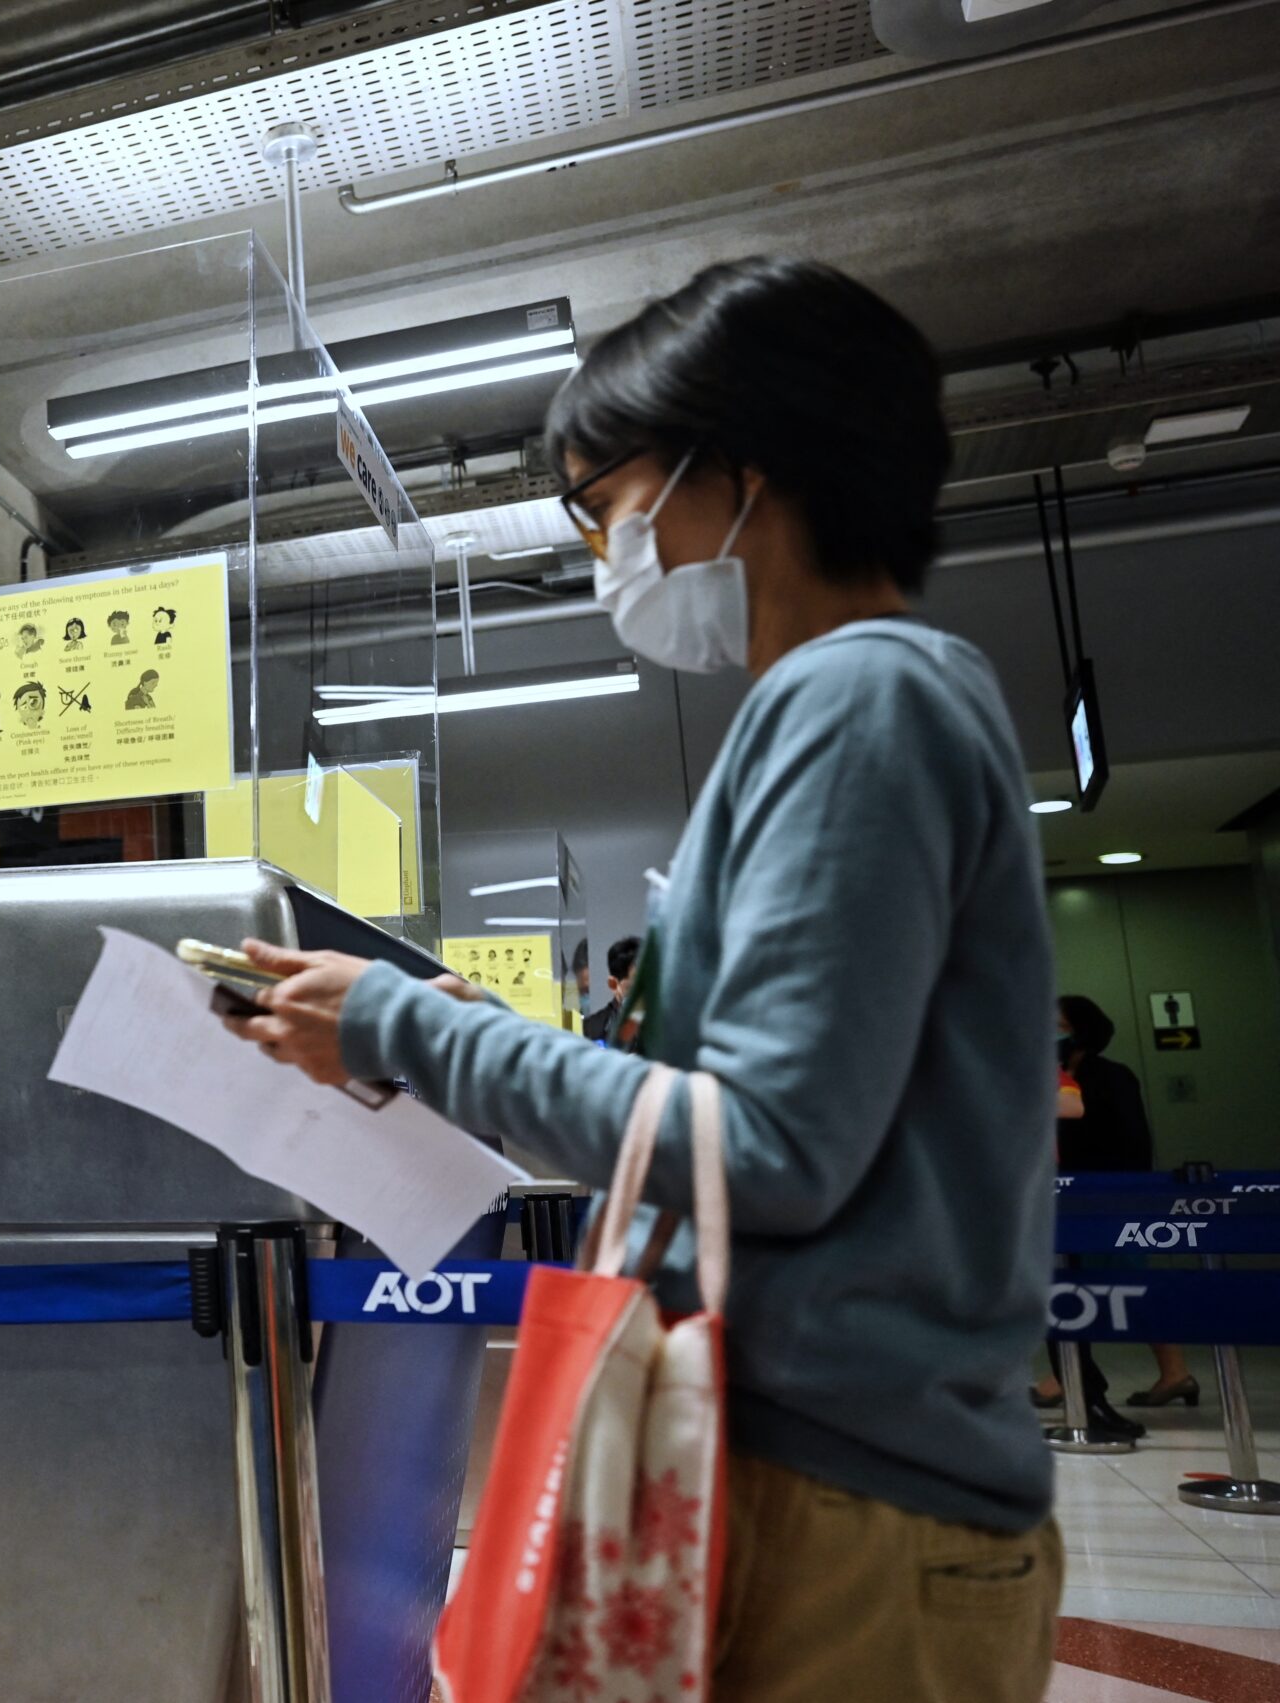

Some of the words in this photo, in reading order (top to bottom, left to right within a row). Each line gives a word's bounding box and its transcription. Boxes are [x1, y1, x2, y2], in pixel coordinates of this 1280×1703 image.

[357, 454, 377, 504] care
[8, 604, 19, 612] any
[42, 596, 74, 606] following
[75, 591, 111, 601] symptoms
[1169, 1198, 1238, 1214] AOT
[1115, 1222, 1208, 1248] AOT
[362, 1271, 492, 1314] AOT
[1047, 1283, 1148, 1331] OT
